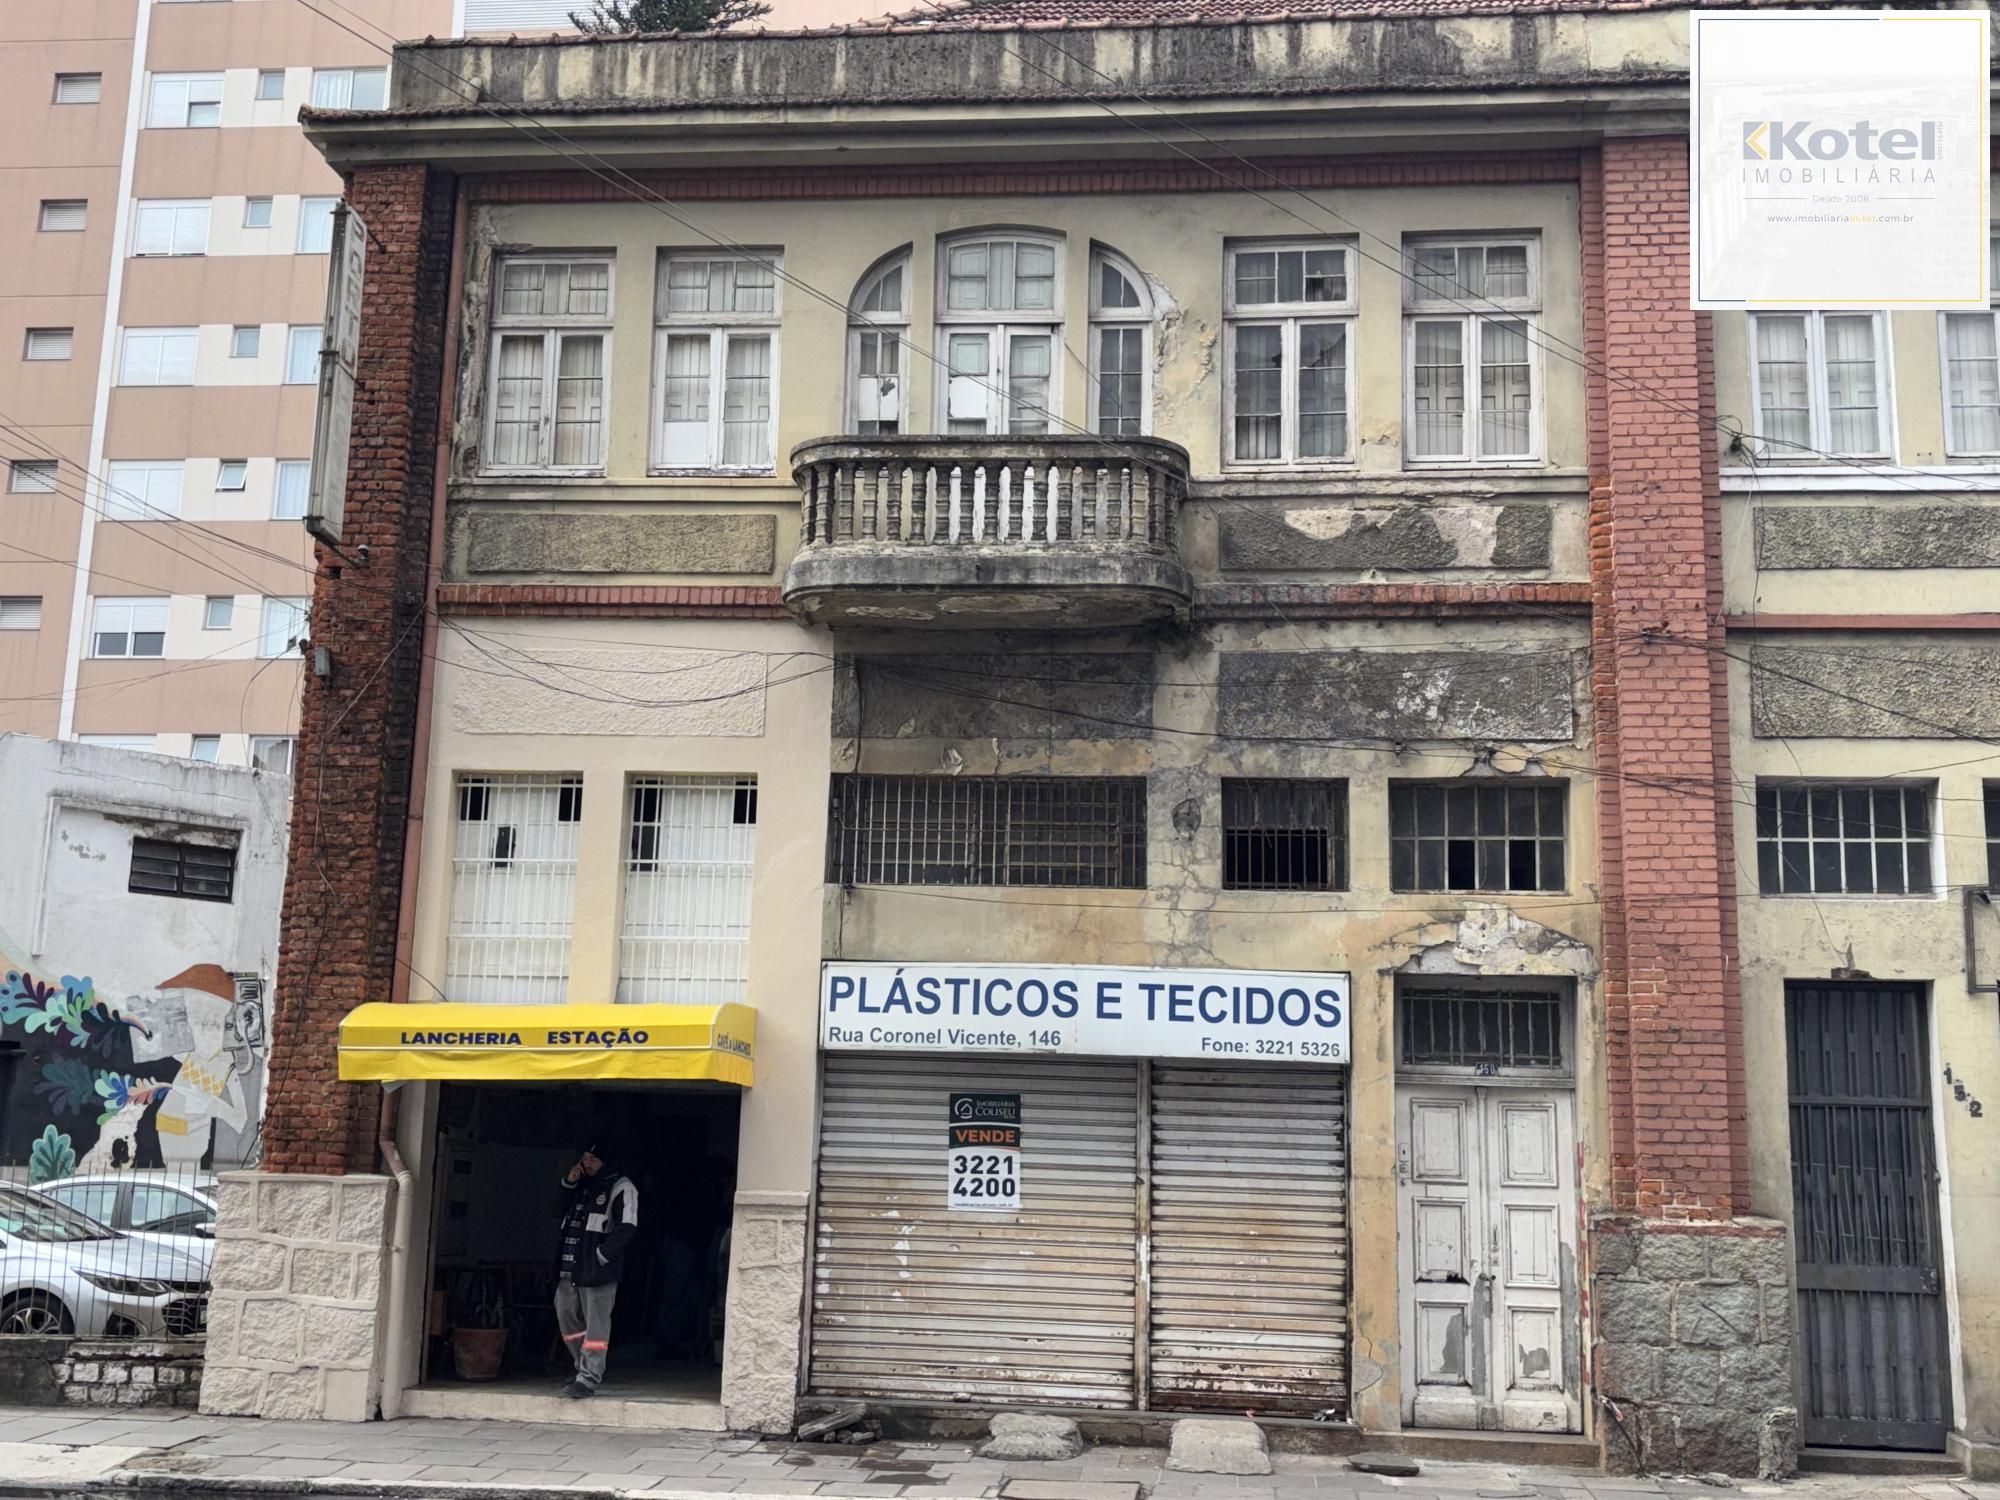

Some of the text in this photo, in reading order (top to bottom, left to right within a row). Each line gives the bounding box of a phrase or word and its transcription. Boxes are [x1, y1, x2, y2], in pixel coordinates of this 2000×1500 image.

[829, 969, 1342, 1028] PLÁSTICOS E TECIDOS
[401, 1028, 649, 1048] LANCHERIA ESTAÇÃO
[829, 1027, 1062, 1048] Rua Coronel Vicente, 146
[1201, 1037, 1341, 1058] Fone: 3221 5326
[955, 1129, 1016, 1143] VENDE
[953, 1155, 1013, 1175] 3221
[952, 1177, 1016, 1198] 4200
